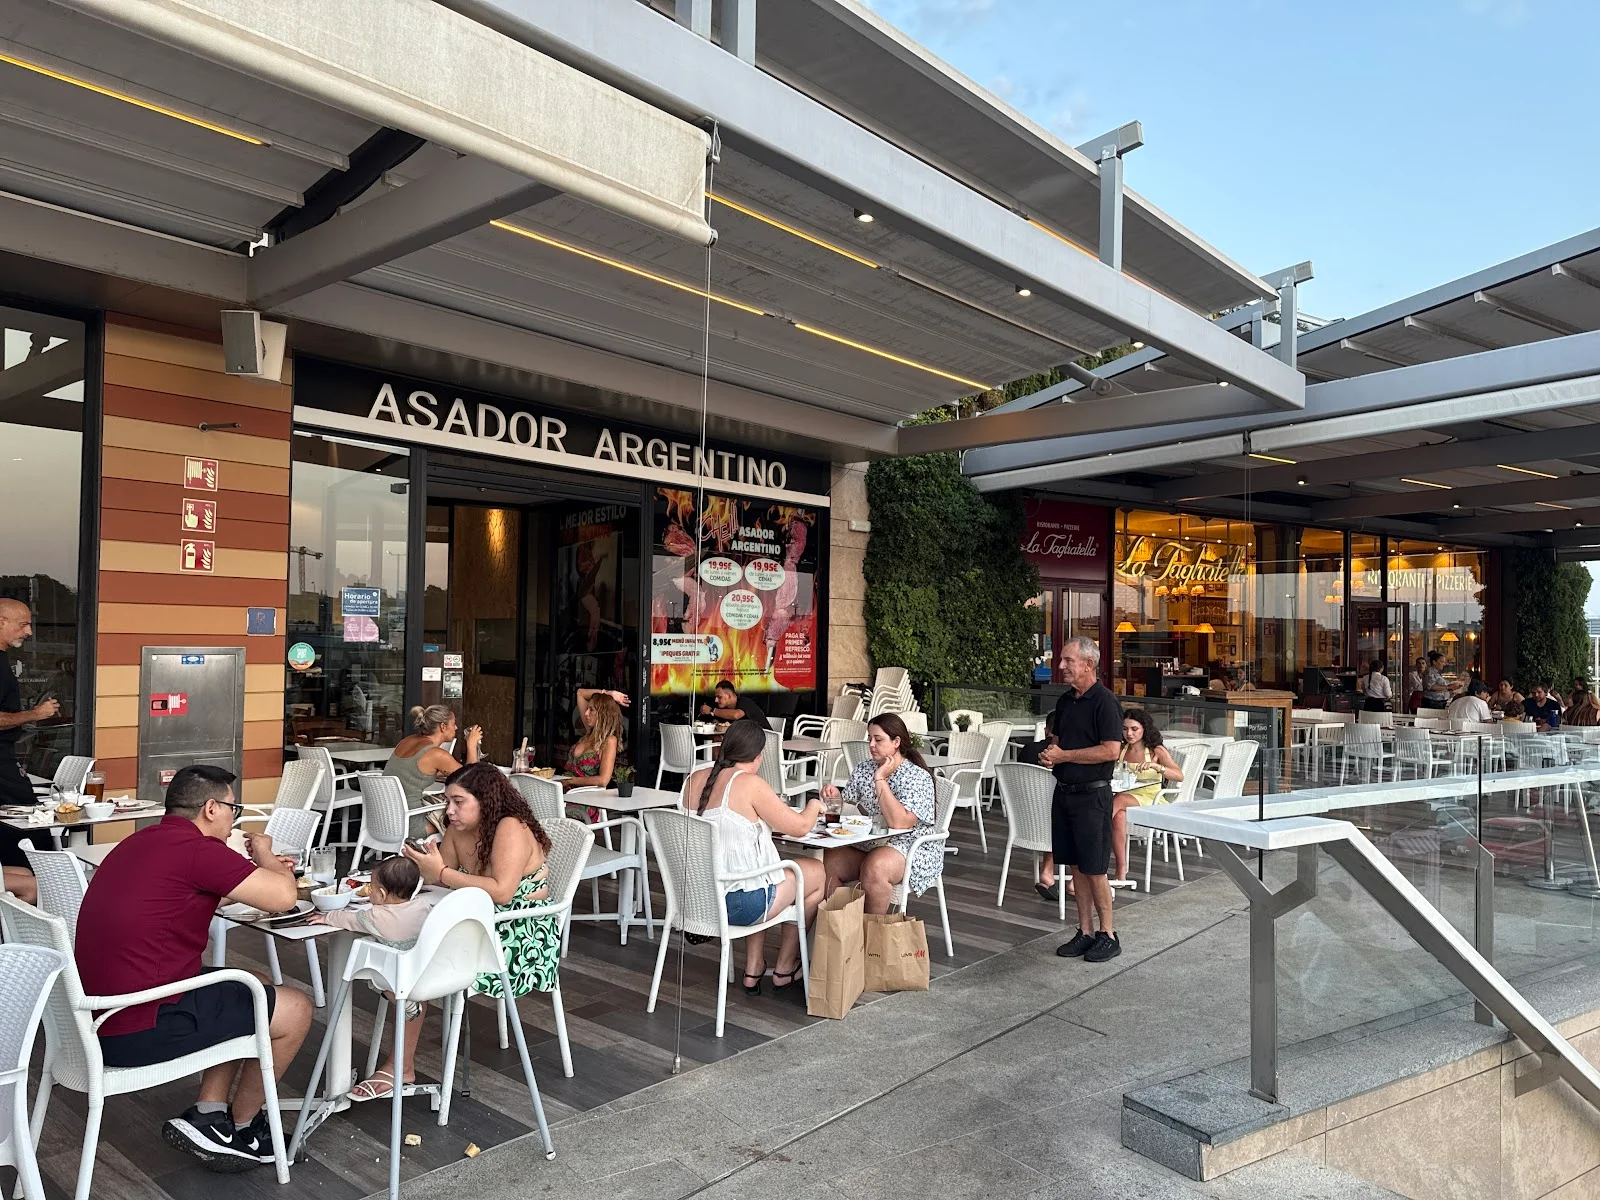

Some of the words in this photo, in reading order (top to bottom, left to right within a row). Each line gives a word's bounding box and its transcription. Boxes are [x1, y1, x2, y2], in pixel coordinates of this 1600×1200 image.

[367, 382, 568, 453] ASADOR
[593, 428, 788, 490] ARGENTINO
[565, 509, 594, 529] MEJOR
[595, 504, 627, 523] ESTILO
[739, 526, 775, 540] ASADOR
[731, 540, 781, 555] ARGENTINO
[1021, 531, 1040, 554] La
[1040, 533, 1097, 560] Tagliatella
[708, 560, 733, 571] 19,95€
[752, 561, 779, 572] 19,95€
[1115, 535, 1147, 578] La
[1152, 541, 1248, 586] Tagliatella
[344, 592, 371, 600] Horario
[731, 594, 755, 603] 20,95€
[256, 612, 266, 625] R
[653, 638, 672, 647] 8,95€
